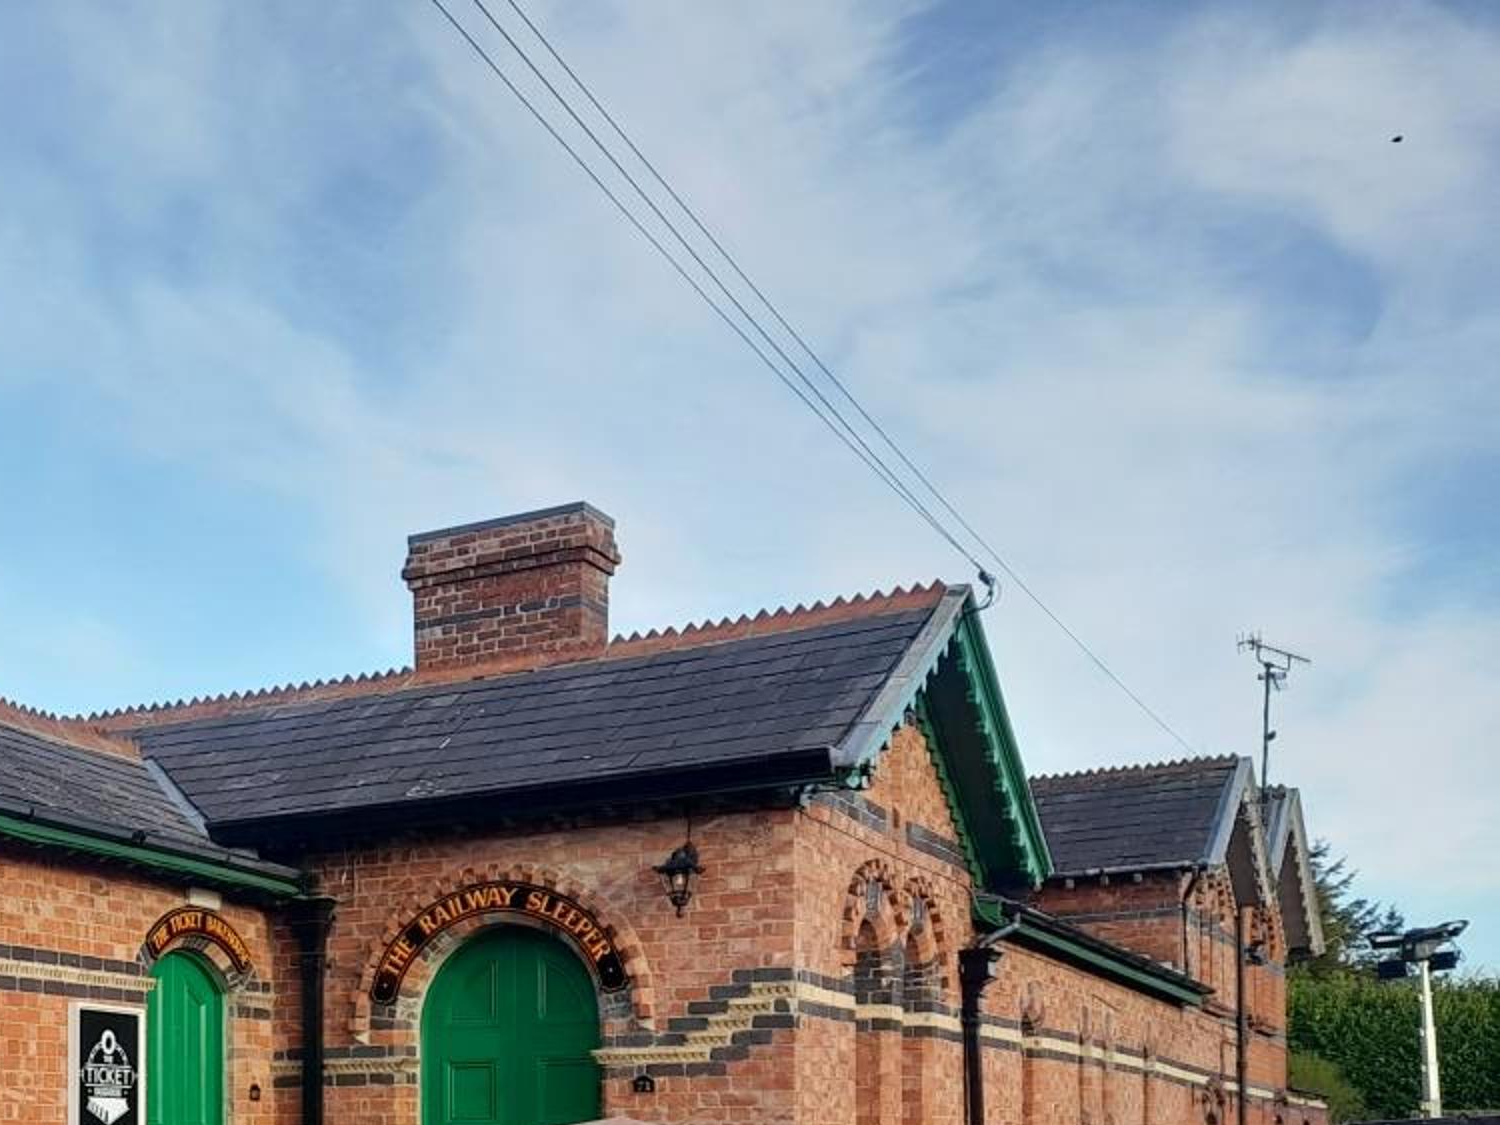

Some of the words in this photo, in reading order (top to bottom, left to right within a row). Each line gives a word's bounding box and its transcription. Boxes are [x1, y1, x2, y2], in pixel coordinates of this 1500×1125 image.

[171, 912, 202, 933] TICKET
[384, 937, 417, 976] THE
[419, 887, 517, 934] RAILWAY
[526, 891, 612, 962] SLEEPER
[86, 1067, 131, 1085] TICKET
